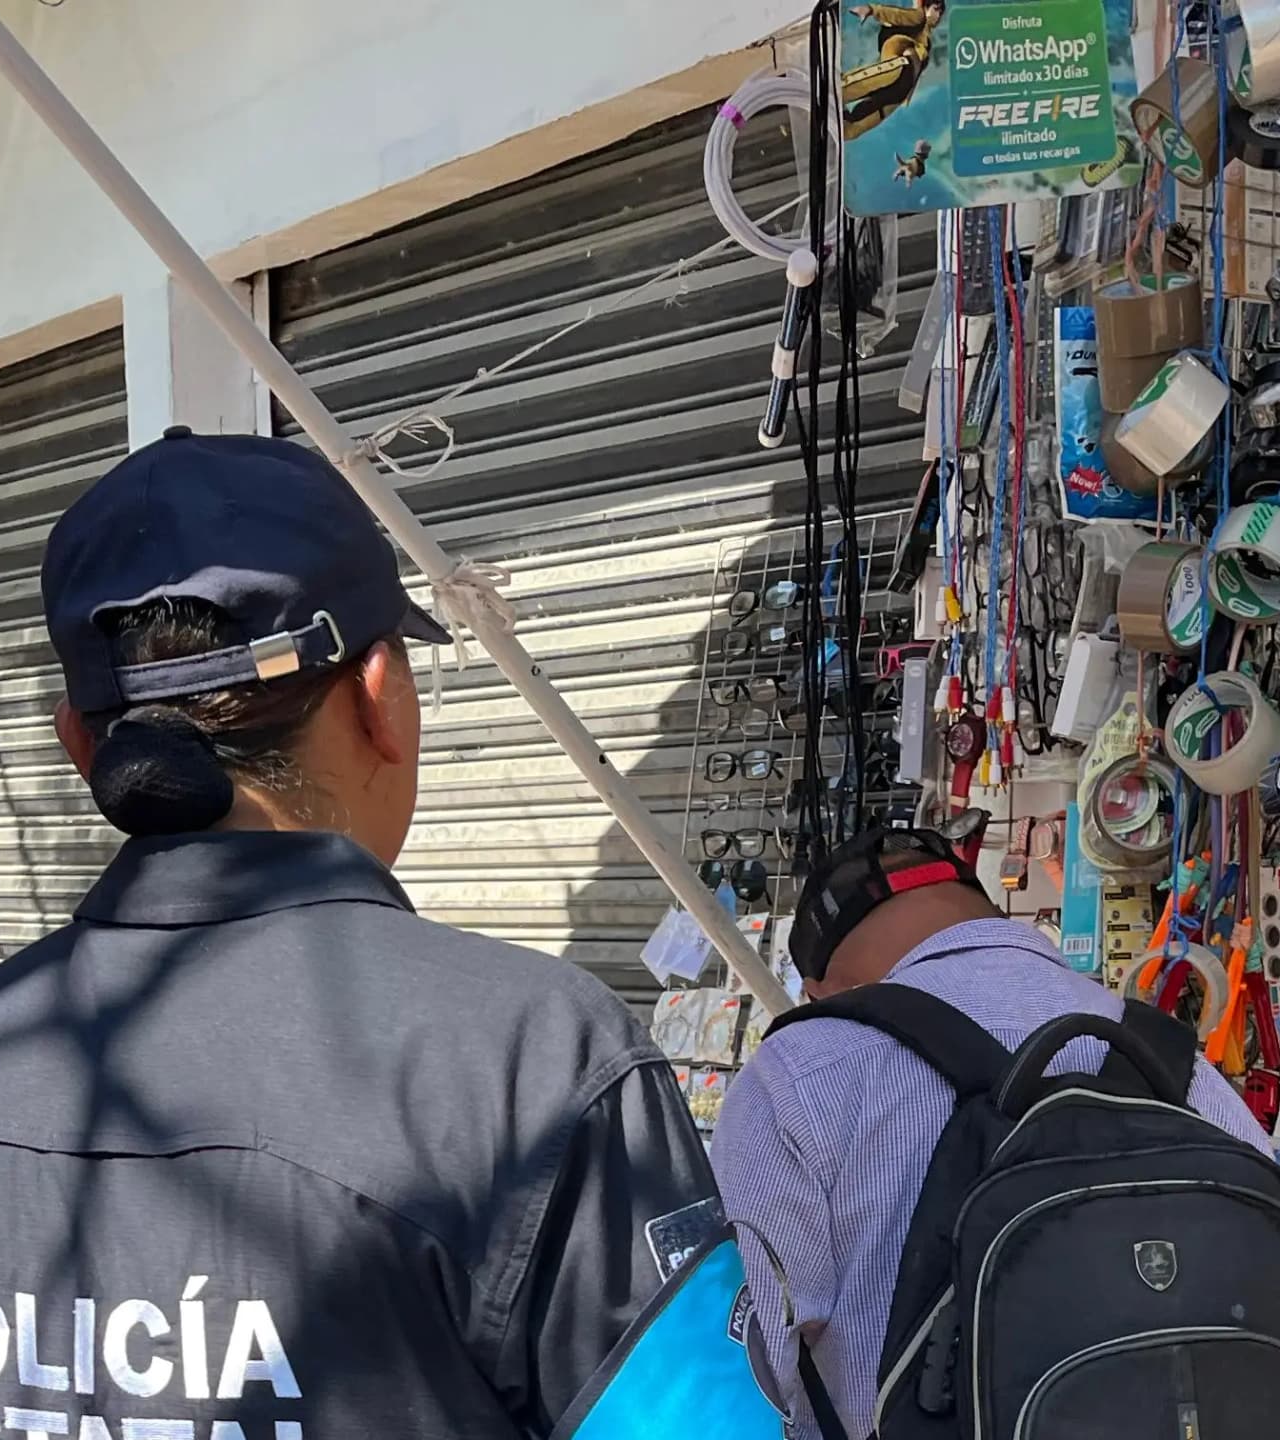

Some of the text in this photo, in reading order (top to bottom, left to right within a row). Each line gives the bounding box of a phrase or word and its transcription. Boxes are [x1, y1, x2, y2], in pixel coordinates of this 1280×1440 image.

[1002, 16, 1043, 30] Disfruta
[983, 69, 1034, 86] ilimitado
[1063, 64, 1089, 79] días
[957, 94, 1102, 130] FREE FIRE
[1001, 127, 1057, 146] ilimitado
[982, 146, 1081, 165] en todas tus recargas
[1070, 470, 1099, 492] Now!
